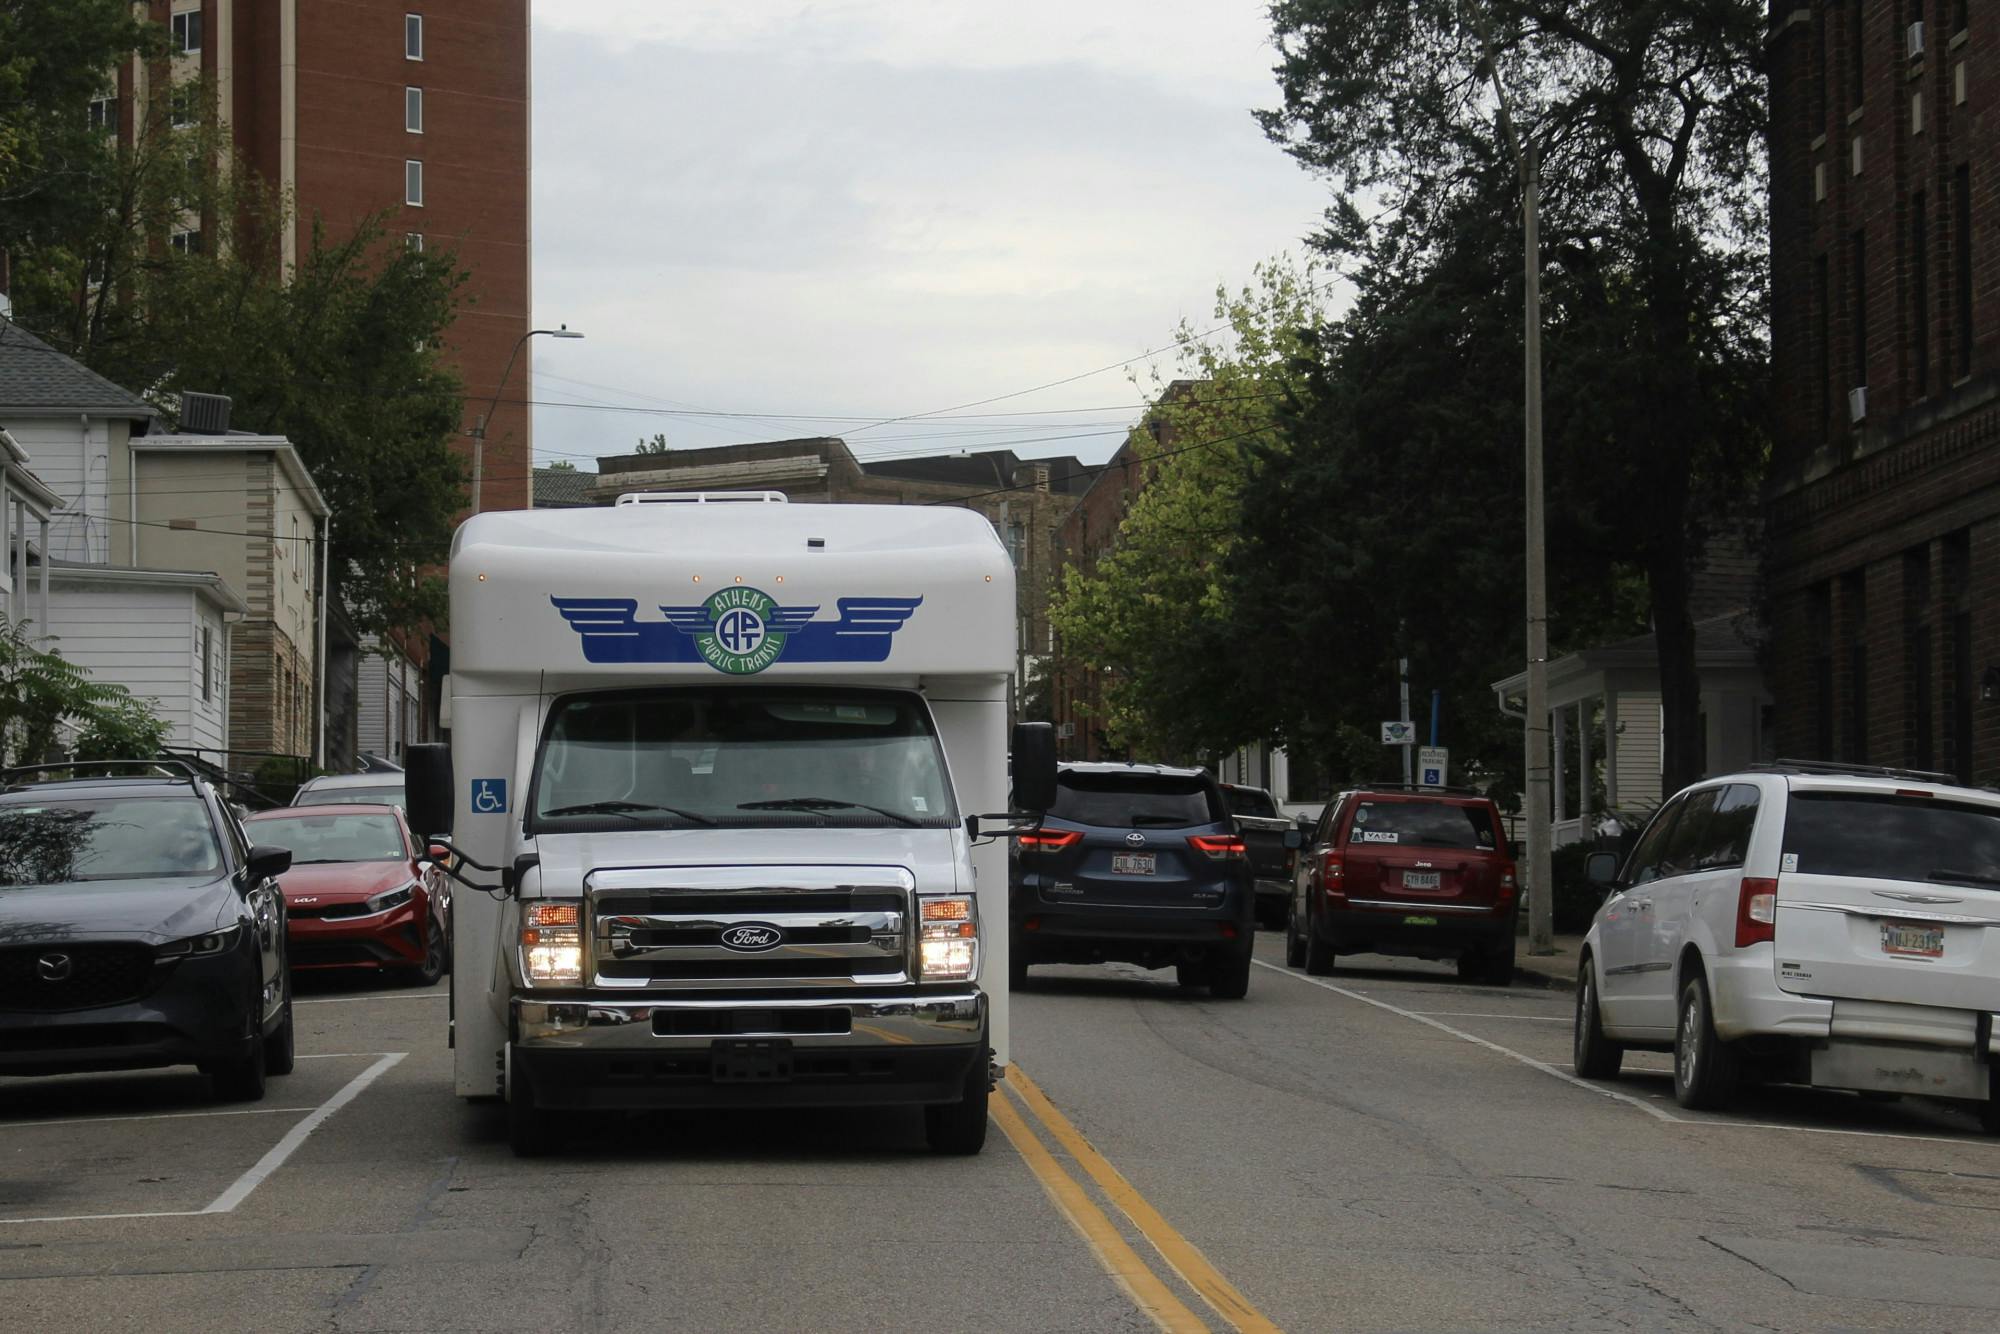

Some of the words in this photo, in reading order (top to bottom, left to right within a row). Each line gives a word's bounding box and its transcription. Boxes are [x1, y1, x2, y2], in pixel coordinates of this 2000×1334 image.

[714, 590, 768, 612] ATHENS
[699, 637, 736, 671] PUBLIC
[740, 636, 781, 672] TRANSIT
[733, 928, 770, 944] Ford
